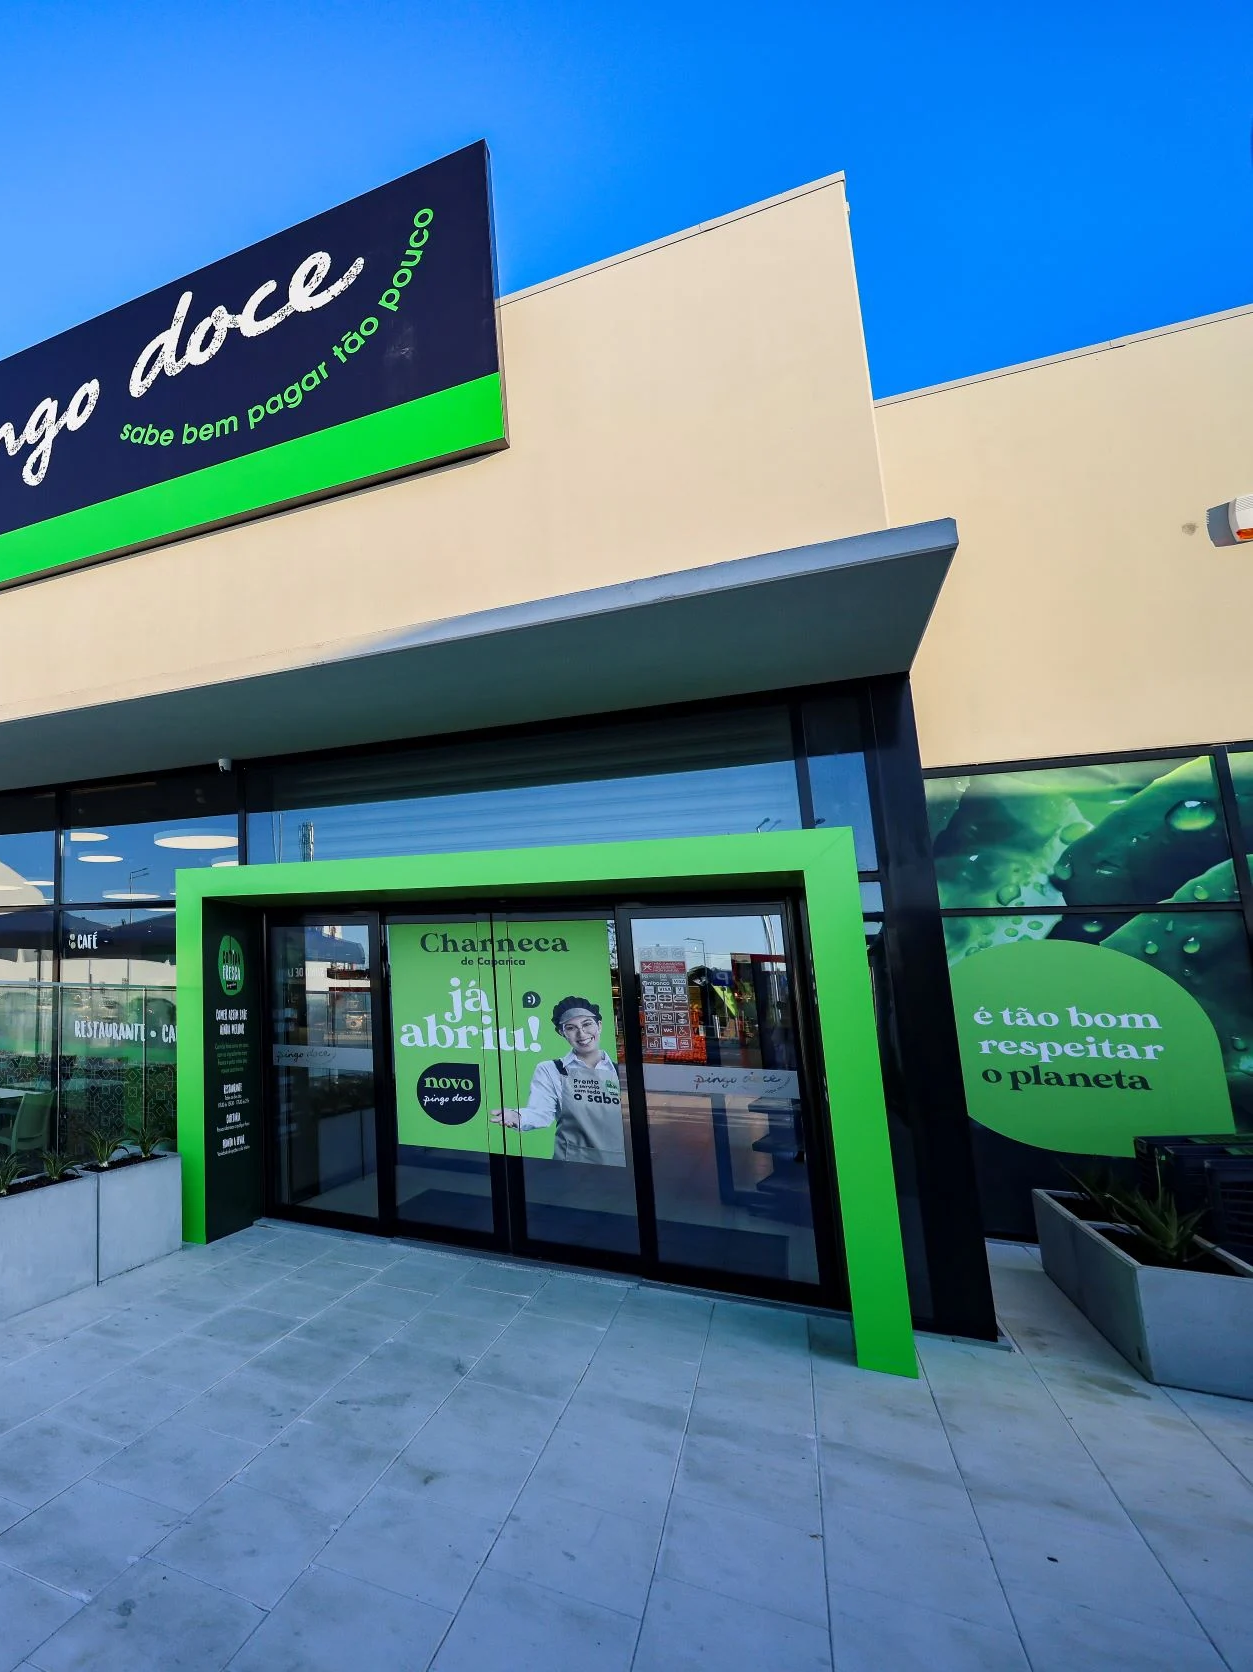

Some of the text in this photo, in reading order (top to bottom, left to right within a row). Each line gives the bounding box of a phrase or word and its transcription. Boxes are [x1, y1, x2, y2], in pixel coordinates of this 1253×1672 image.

[119, 208, 434, 447] sabe bem pagar tão pouco
[129, 251, 364, 398] doce
[77, 931, 98, 950] CAFÉ
[420, 932, 570, 953] Charneca
[461, 956, 526, 968] de Caparica
[444, 976, 494, 1023] já
[973, 1005, 1162, 1029] é tão bom
[74, 1020, 177, 1044] RESTAURANTE CA
[400, 1013, 542, 1053] abriu!
[276, 1049, 304, 1063] pingo
[306, 1047, 331, 1057] doce
[978, 1036, 1165, 1063] respeitar
[423, 1076, 474, 1091] novo
[694, 1072, 737, 1090] pingo
[981, 1064, 1153, 1091] o planeta
[423, 1093, 476, 1107] pingo doce
[573, 1093, 583, 1101] o
